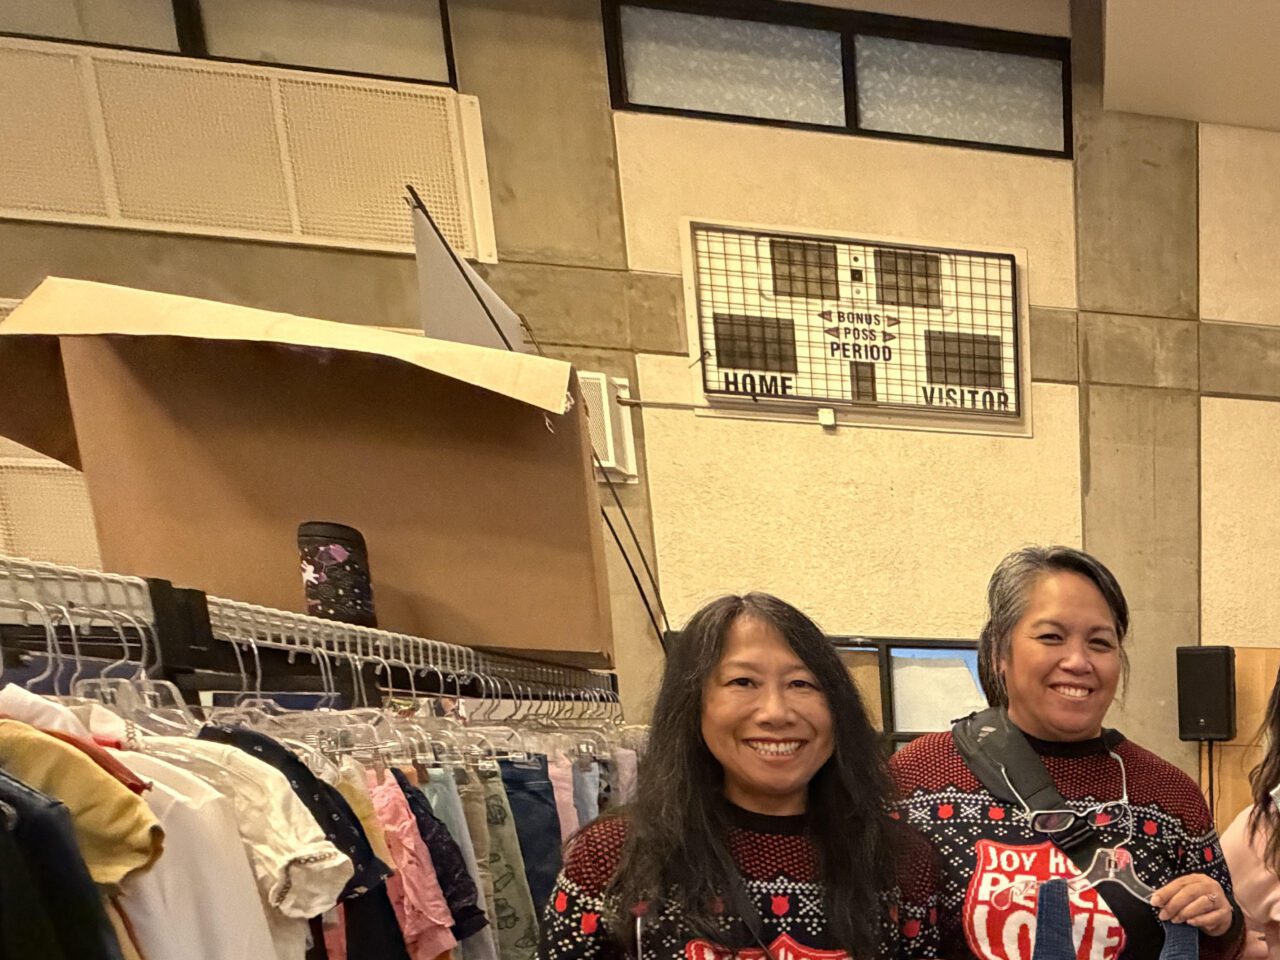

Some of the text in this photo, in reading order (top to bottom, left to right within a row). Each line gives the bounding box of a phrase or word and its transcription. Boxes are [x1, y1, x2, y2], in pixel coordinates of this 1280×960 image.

[837, 311, 881, 326] BONUS
[844, 327, 877, 341] POSS
[830, 341, 892, 362] PERIOD
[723, 372, 1009, 412] HOME VISITOR
[985, 846, 1037, 872] JOY
[978, 872, 1113, 913] PEC
